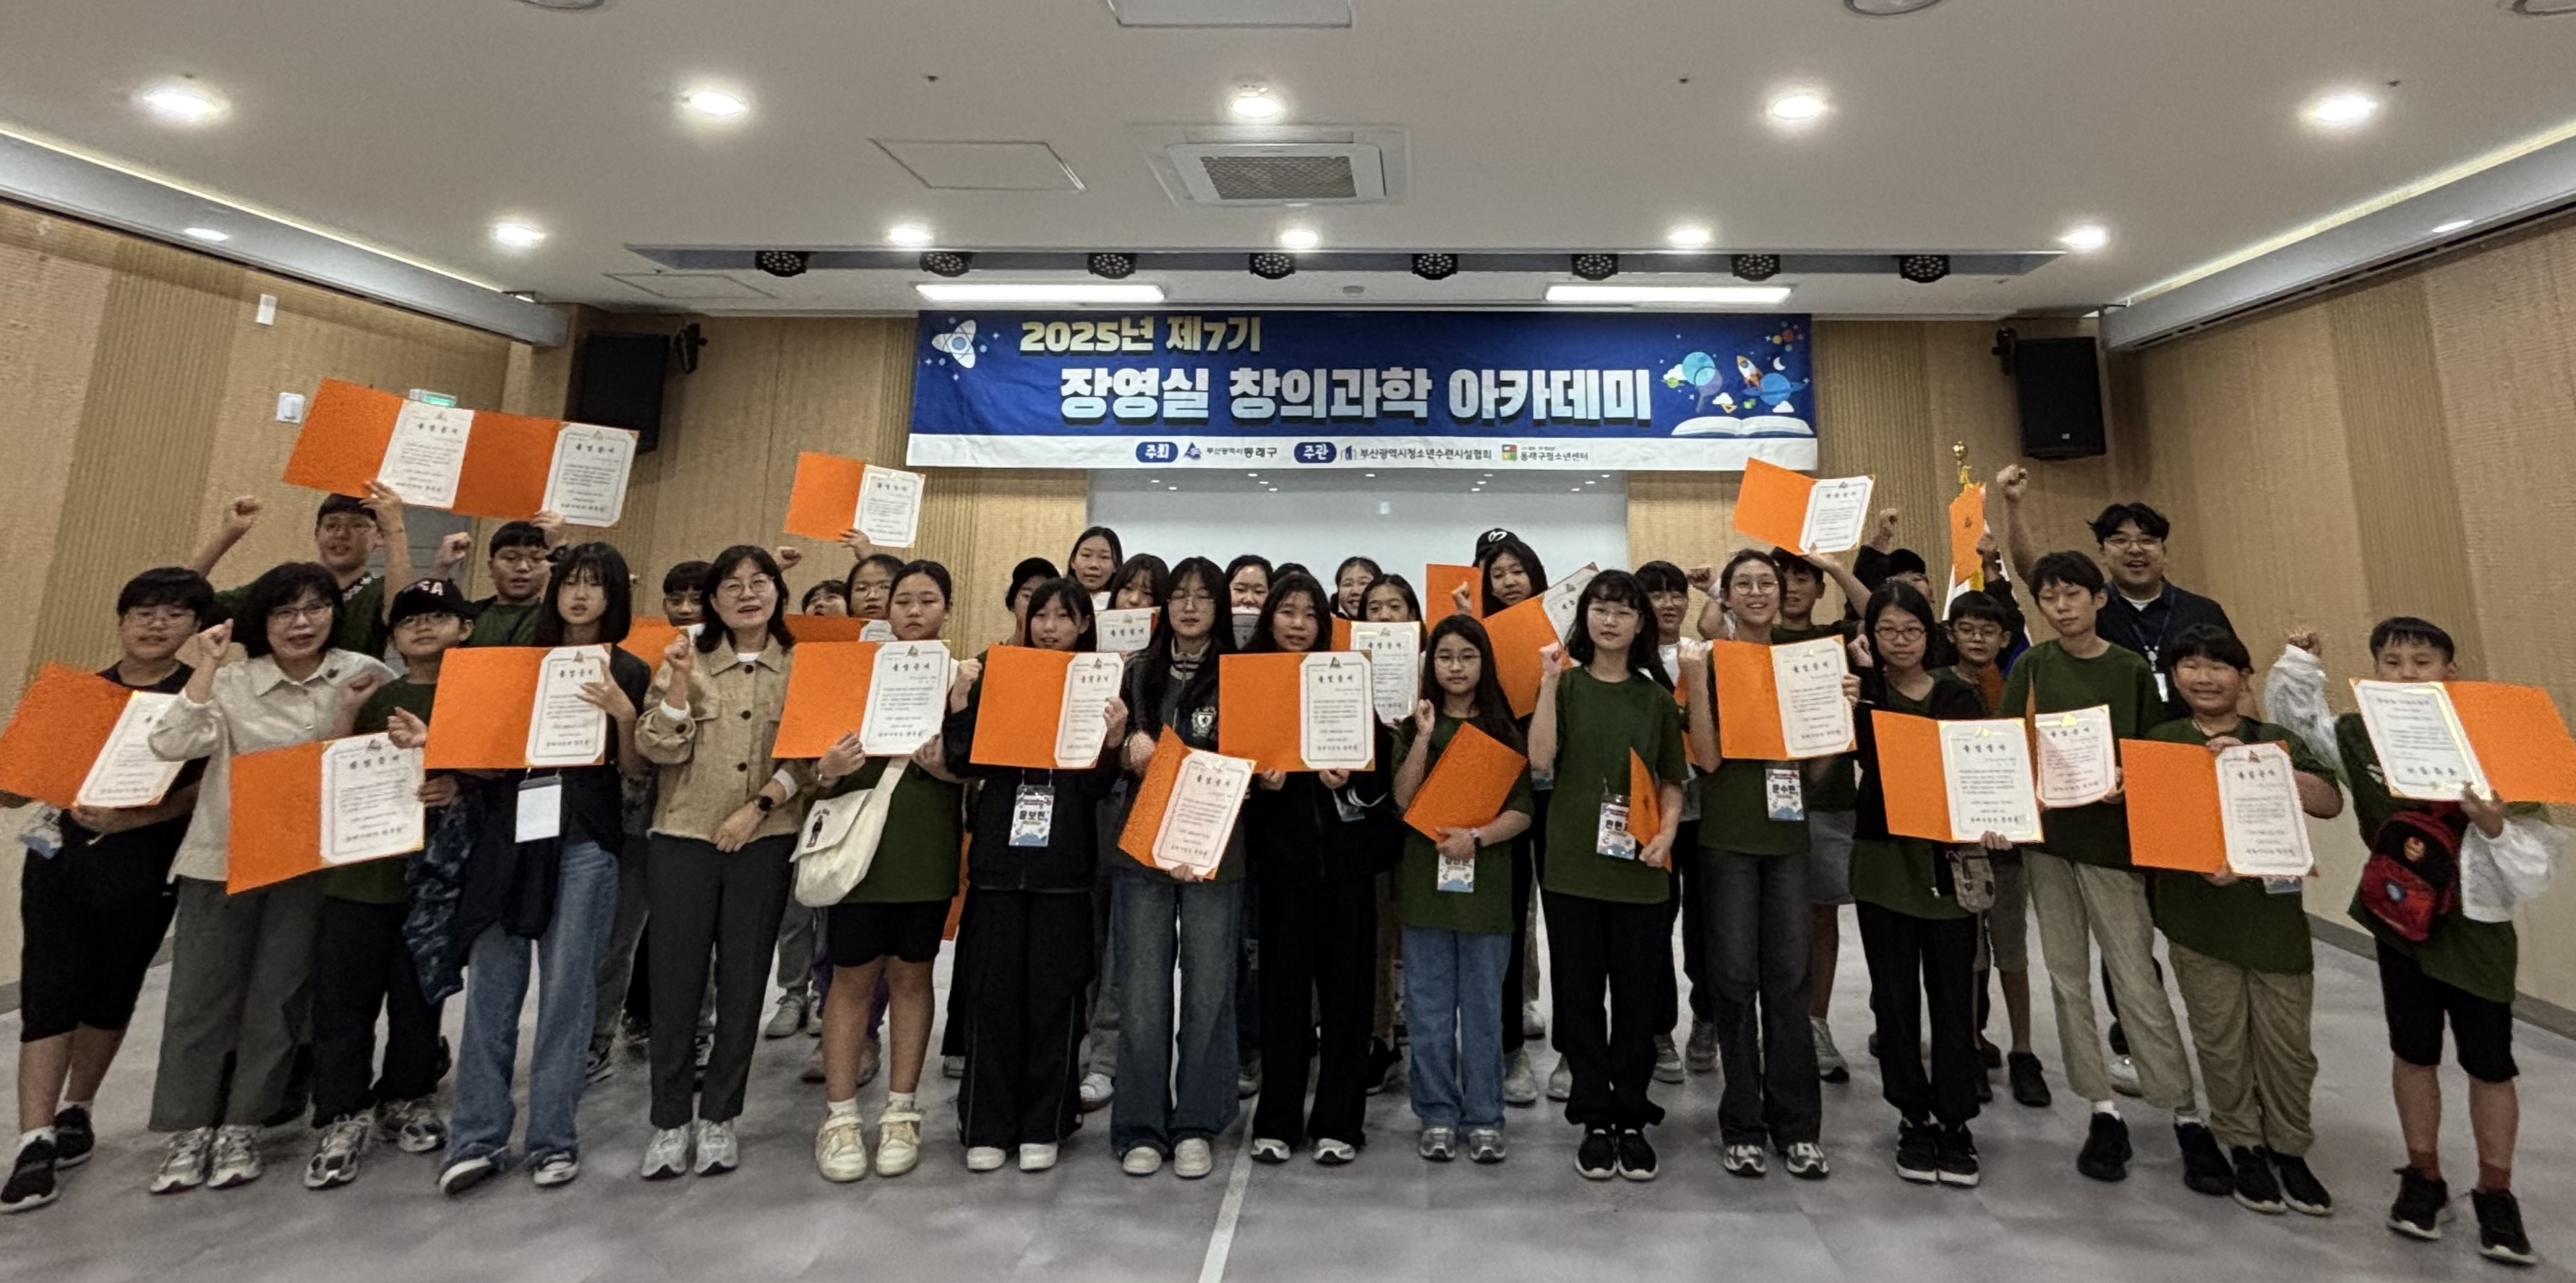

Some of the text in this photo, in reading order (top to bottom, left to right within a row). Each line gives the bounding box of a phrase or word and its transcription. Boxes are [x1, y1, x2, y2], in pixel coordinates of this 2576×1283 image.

[1020, 316, 1260, 353] 2025년 제7기
[1061, 366, 1651, 421] 장영실 창의과학 아카데미
[1144, 443, 1170, 460] 주최
[1303, 443, 1330, 460] 주관
